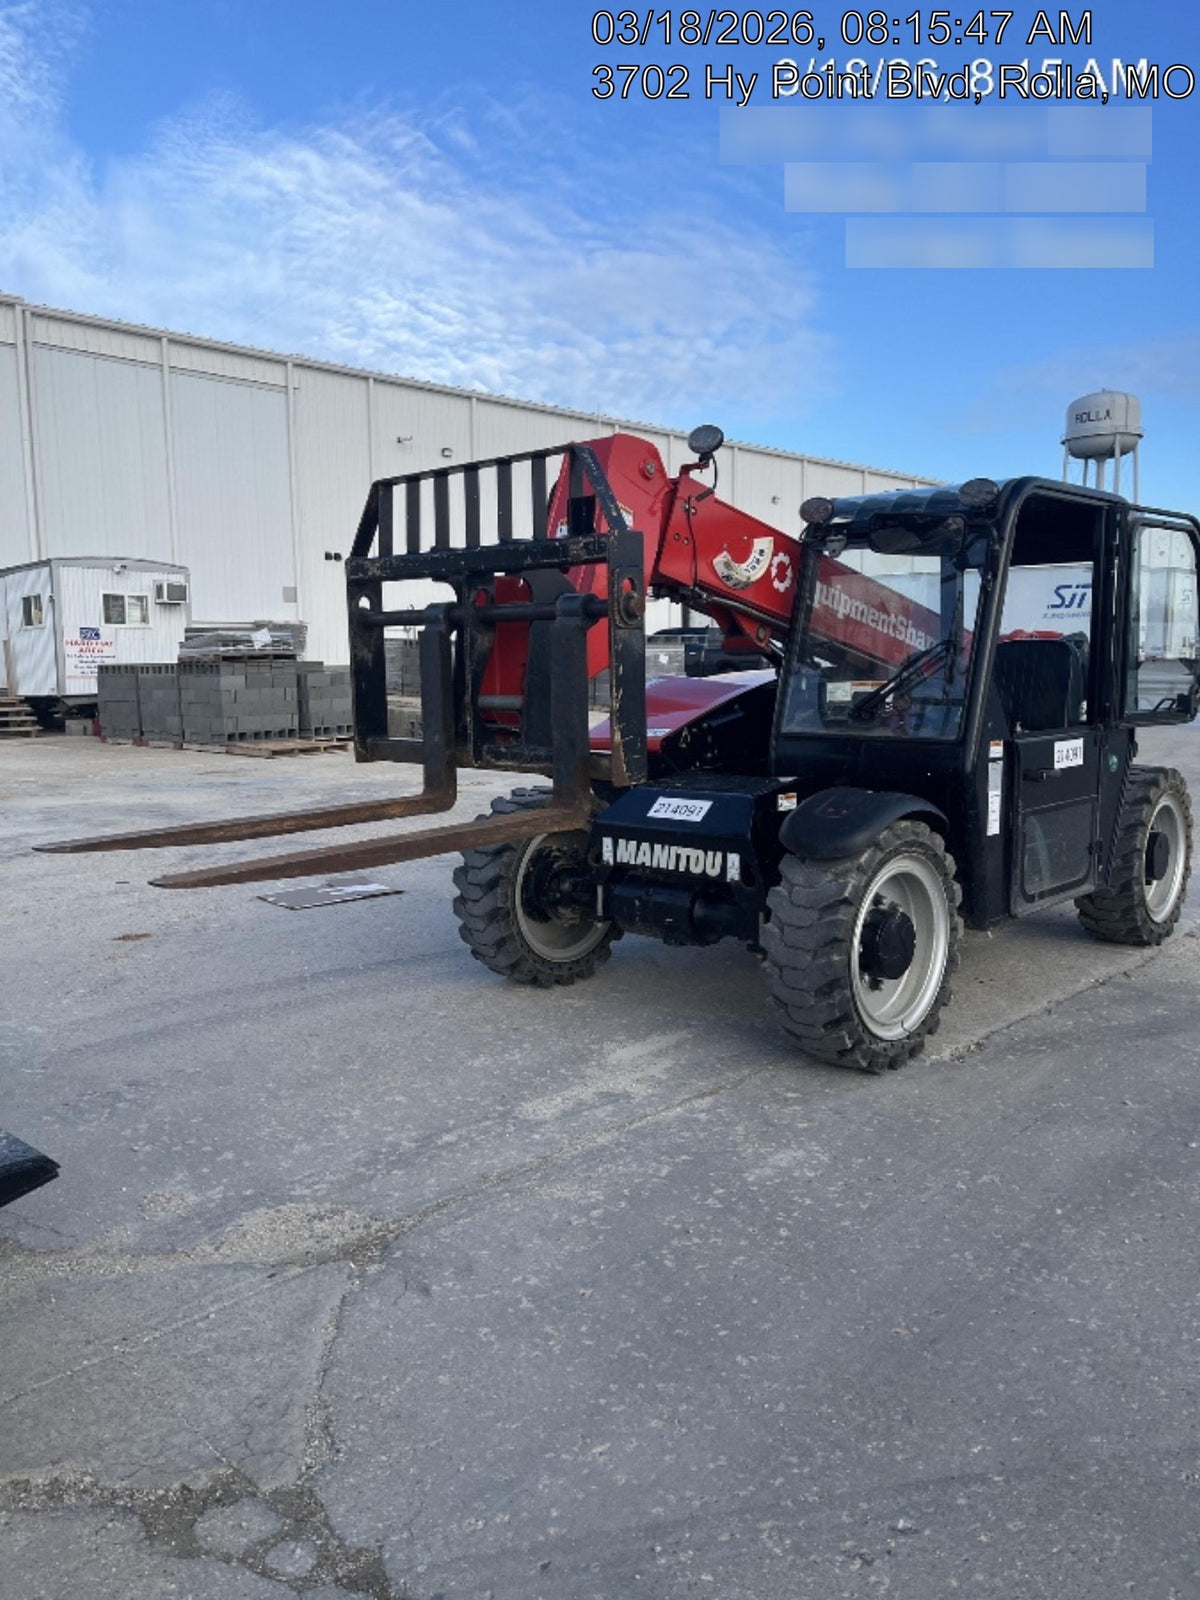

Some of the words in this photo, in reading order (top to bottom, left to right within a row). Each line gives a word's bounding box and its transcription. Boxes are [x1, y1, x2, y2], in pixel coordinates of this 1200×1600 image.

[1075, 409, 1112, 424] ROLLA
[653, 802, 704, 817] 214091
[616, 838, 723, 877] MANITOU
